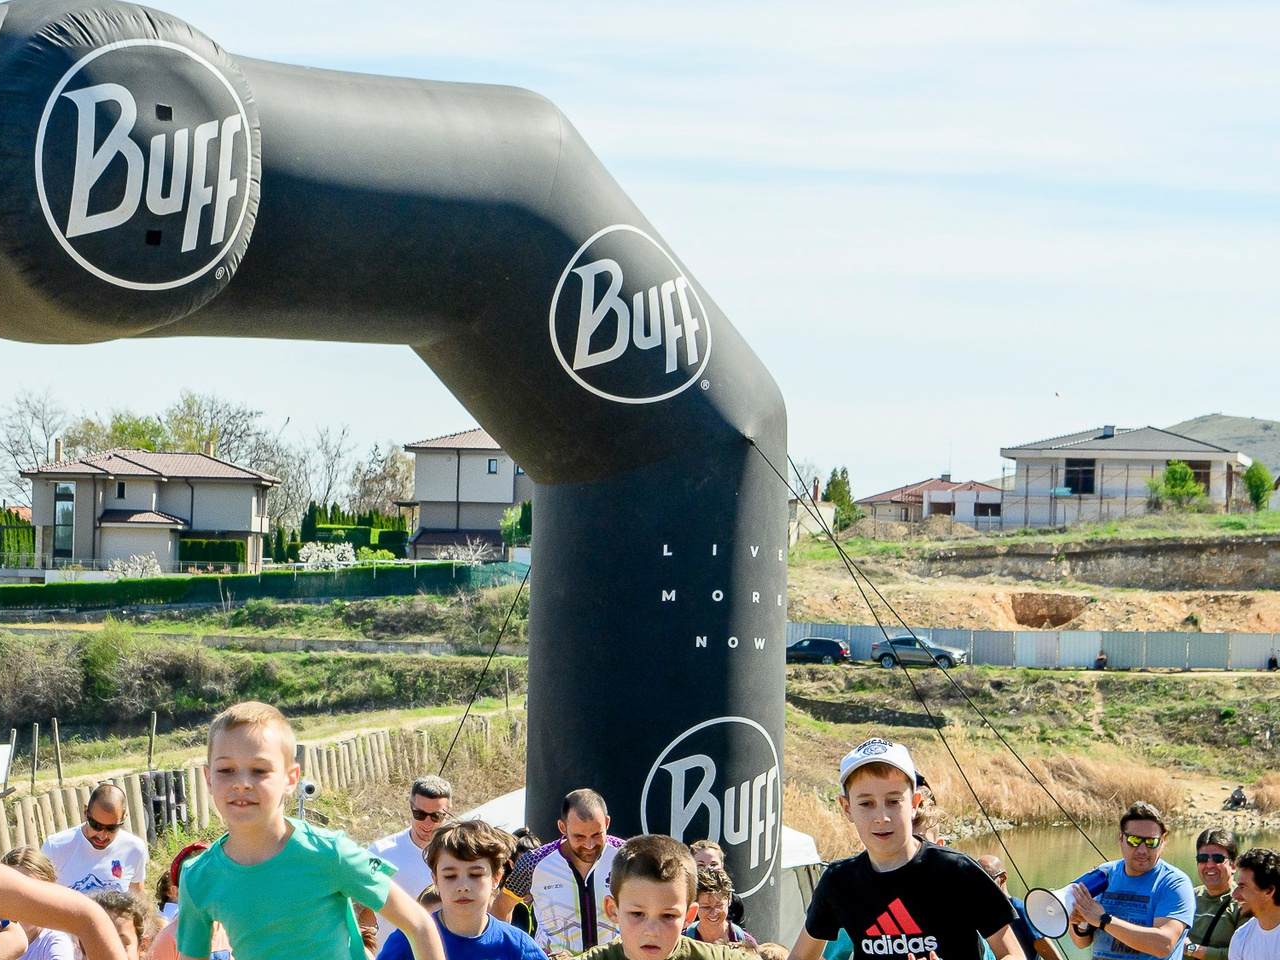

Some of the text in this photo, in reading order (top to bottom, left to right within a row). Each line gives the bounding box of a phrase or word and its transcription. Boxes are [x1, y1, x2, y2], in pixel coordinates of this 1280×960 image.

[662, 543, 783, 562] LIVE
[661, 589, 783, 607] MORE
[695, 636, 766, 650] NOW
[861, 934, 938, 955] adidas
